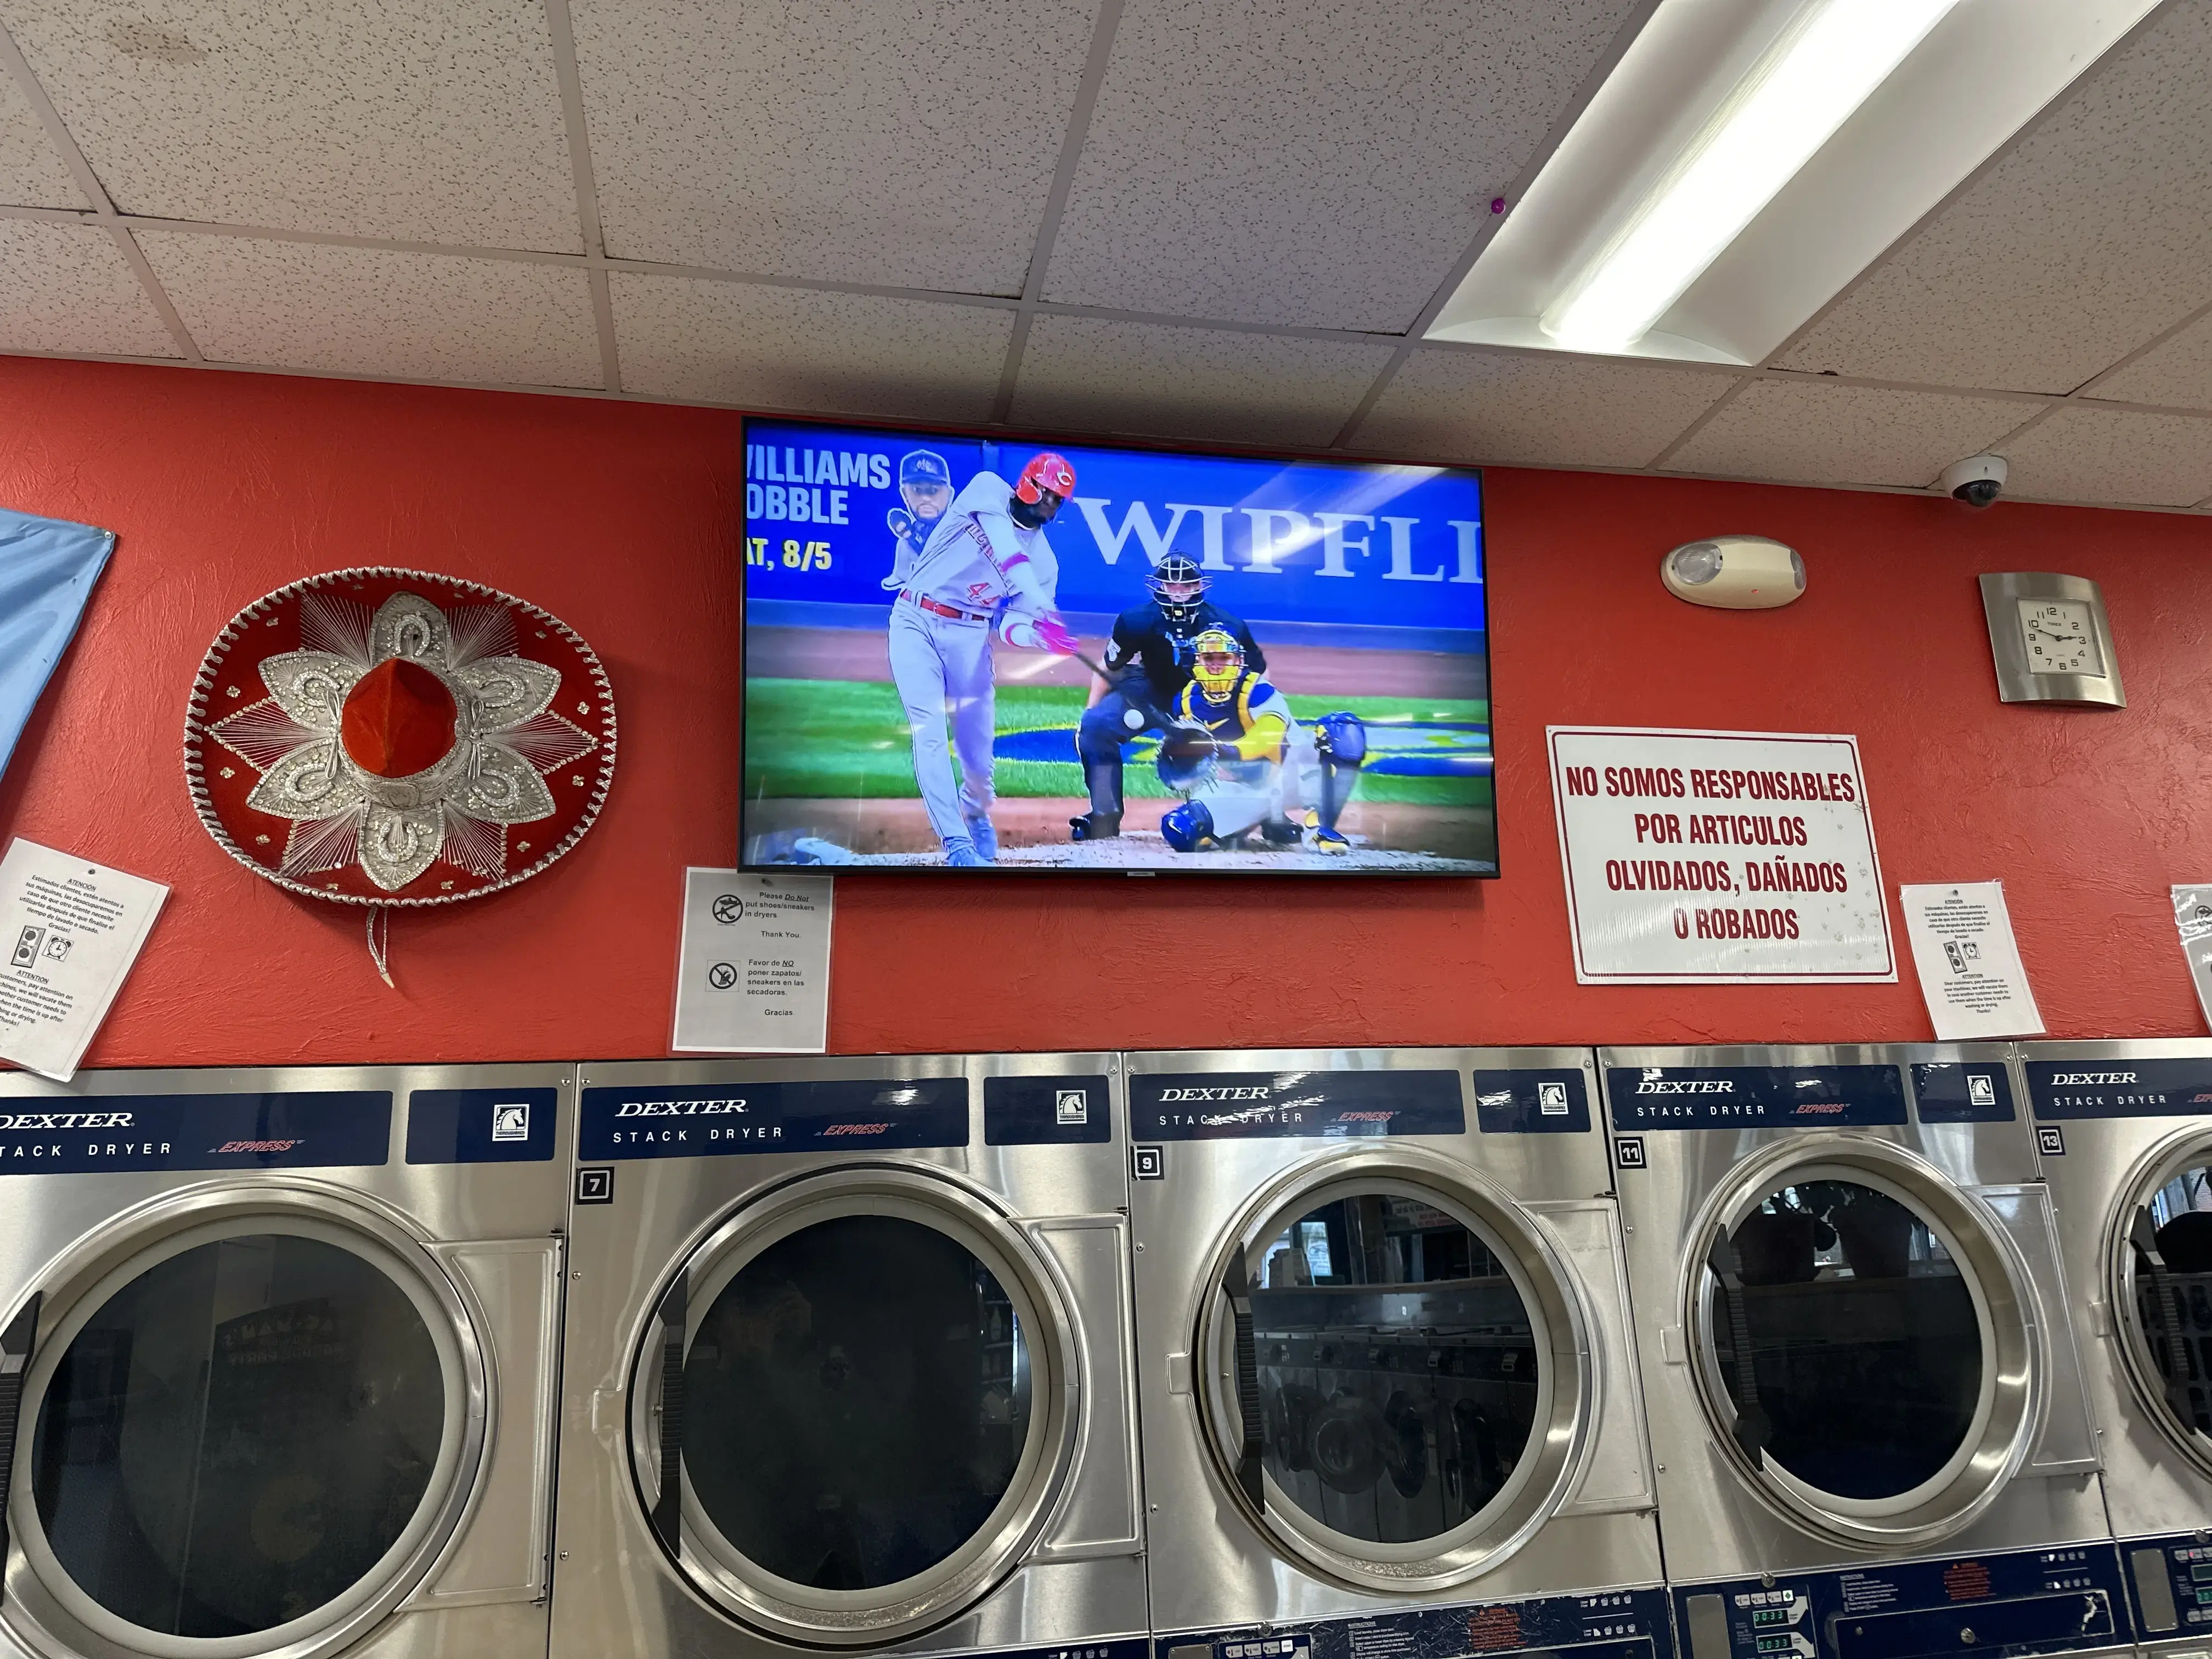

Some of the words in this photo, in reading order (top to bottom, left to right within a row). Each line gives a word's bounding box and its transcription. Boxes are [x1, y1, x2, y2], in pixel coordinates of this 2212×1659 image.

[747, 483, 849, 525] OBBLE
[1073, 496, 1483, 584] WIPFLI
[783, 539, 832, 572] 8/5
[2028, 620, 2039, 628] 10
[2035, 646, 2042, 654] 8
[1566, 766, 1598, 796] NO
[1604, 766, 1685, 798] SOMOS
[1690, 769, 1855, 802] RESPONSABLES
[1634, 813, 1683, 843] POR
[1690, 814, 1808, 847] ARTICULOS
[1606, 860, 1741, 896] OLVIDADOS,
[1745, 855, 1847, 893] DAÑADOS
[31, 874, 60, 888] Estimados
[60, 884, 82, 896] clientes,
[99, 898, 120, 907] atentos
[67, 878, 97, 892] ATENCIÓN
[35, 885, 63, 898] máquinas,
[72, 897, 115, 914] desocuparemos
[785, 894, 795, 902] Do
[46, 905, 69, 916] después
[759, 901, 815, 911] shoes/sneakers
[72, 905, 91, 915] cliente
[91, 911, 114, 922] necesite
[26, 907, 47, 917] tiempo
[55, 915, 74, 926] lavado
[78, 924, 99, 934] secado.
[1673, 907, 1688, 939] O
[1695, 908, 1799, 940] ROBADOS
[48, 922, 71, 934] Gracias!
[16, 970, 49, 985] ATTENTION
[39, 986, 65, 998] attention
[16, 996, 43, 1007] customer
[42, 1005, 60, 1013] needs
[39, 995, 57, 1004] vacate
[57, 1000, 72, 1009] them
[22, 1006, 36, 1014] time
[18, 1013, 36, 1024] drying.
[2051, 1073, 2137, 1085] DEXTER
[1159, 1087, 1269, 1101] DEXTER
[1635, 1081, 1733, 1094] DEXTER
[1795, 1103, 1844, 1113] EXPRESS
[2054, 1097, 2104, 1107] STACK
[2118, 1096, 2166, 1105] DRYER
[615, 1100, 746, 1117] DEXTER
[1638, 1107, 1694, 1116] STACK
[1711, 1106, 1764, 1115] DRYER
[1159, 1114, 1222, 1125] STAC
[1242, 1113, 1302, 1124] DRYER
[1338, 1111, 1394, 1121] EXPRESS
[614, 1131, 687, 1143] STACK
[711, 1127, 781, 1139] DRYER
[823, 1124, 889, 1136] EXPRESS
[218, 1140, 296, 1153] EXPRESS
[2042, 1136, 2058, 1147] 13
[89, 1143, 170, 1155] DRYER
[1623, 1148, 1639, 1160] 11
[1143, 1158, 1152, 1170] 9
[589, 1178, 600, 1192] 7
